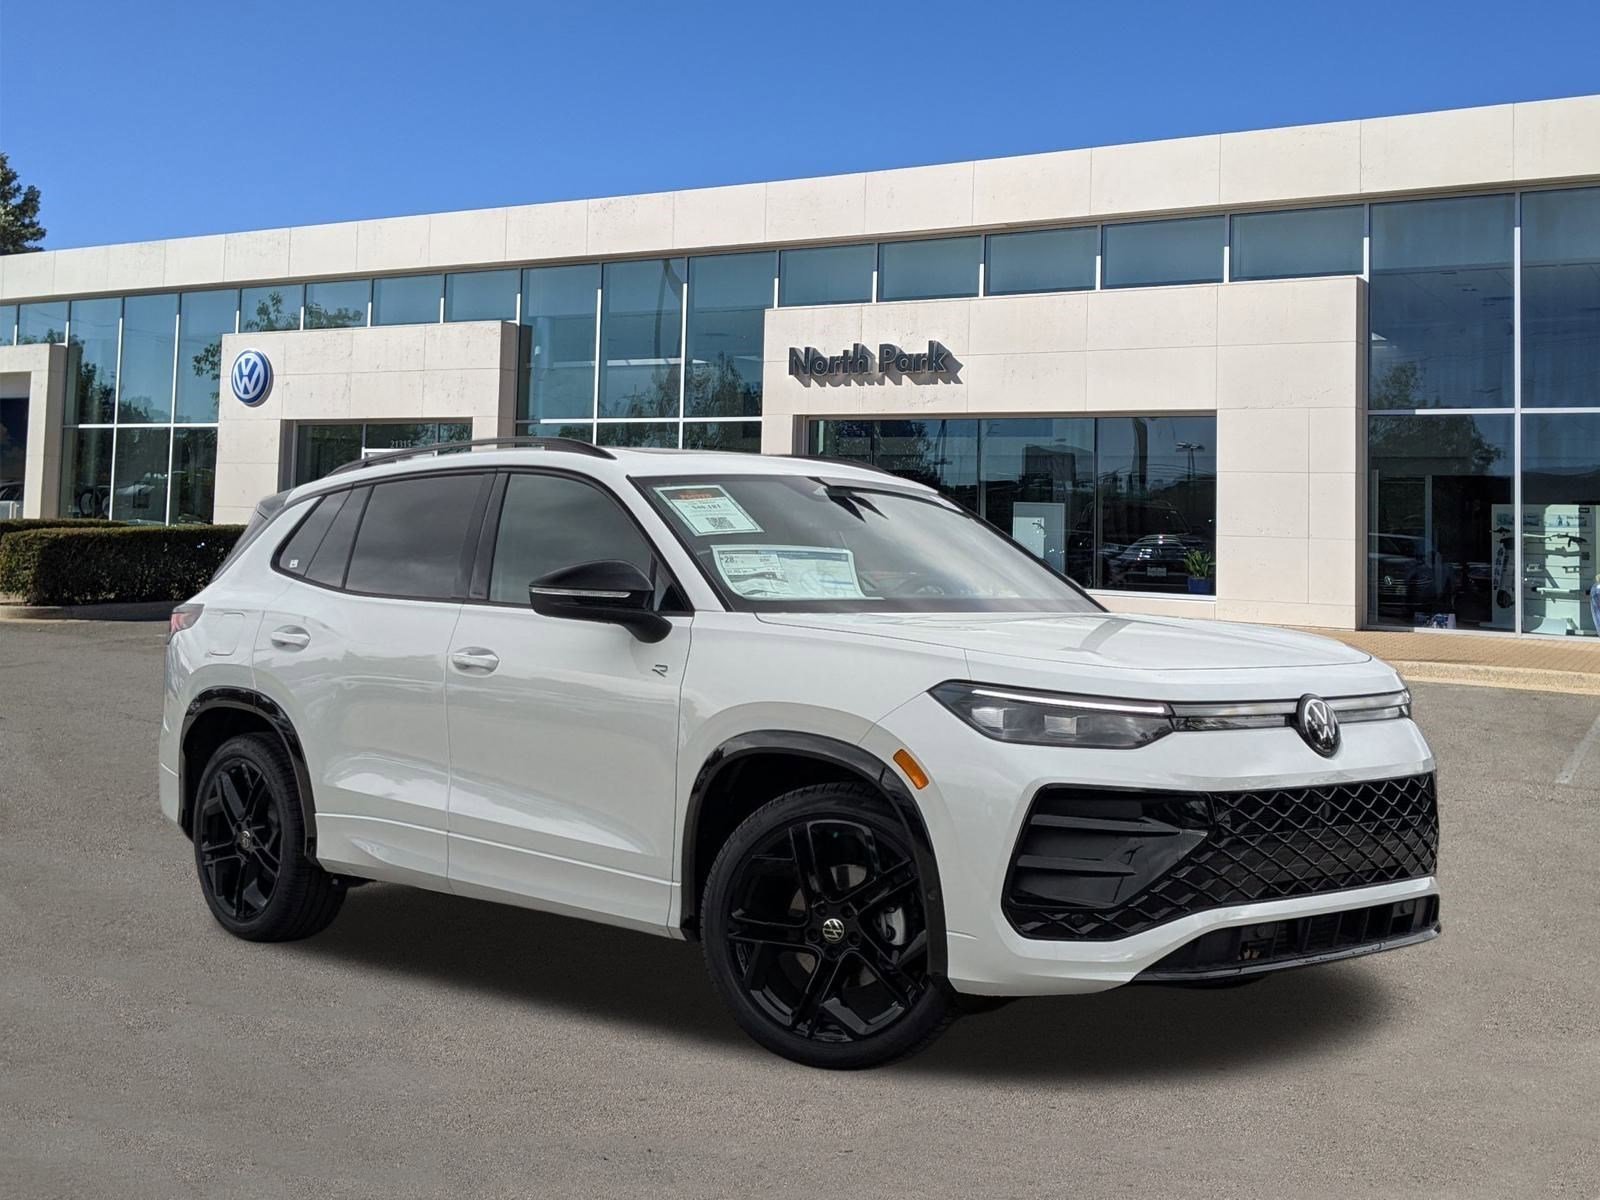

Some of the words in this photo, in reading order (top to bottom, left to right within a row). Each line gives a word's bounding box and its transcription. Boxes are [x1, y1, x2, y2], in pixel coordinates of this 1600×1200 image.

[232, 351, 268, 402] VW
[789, 343, 873, 377] North
[878, 340, 948, 374] Park
[1302, 697, 1341, 755] VW
